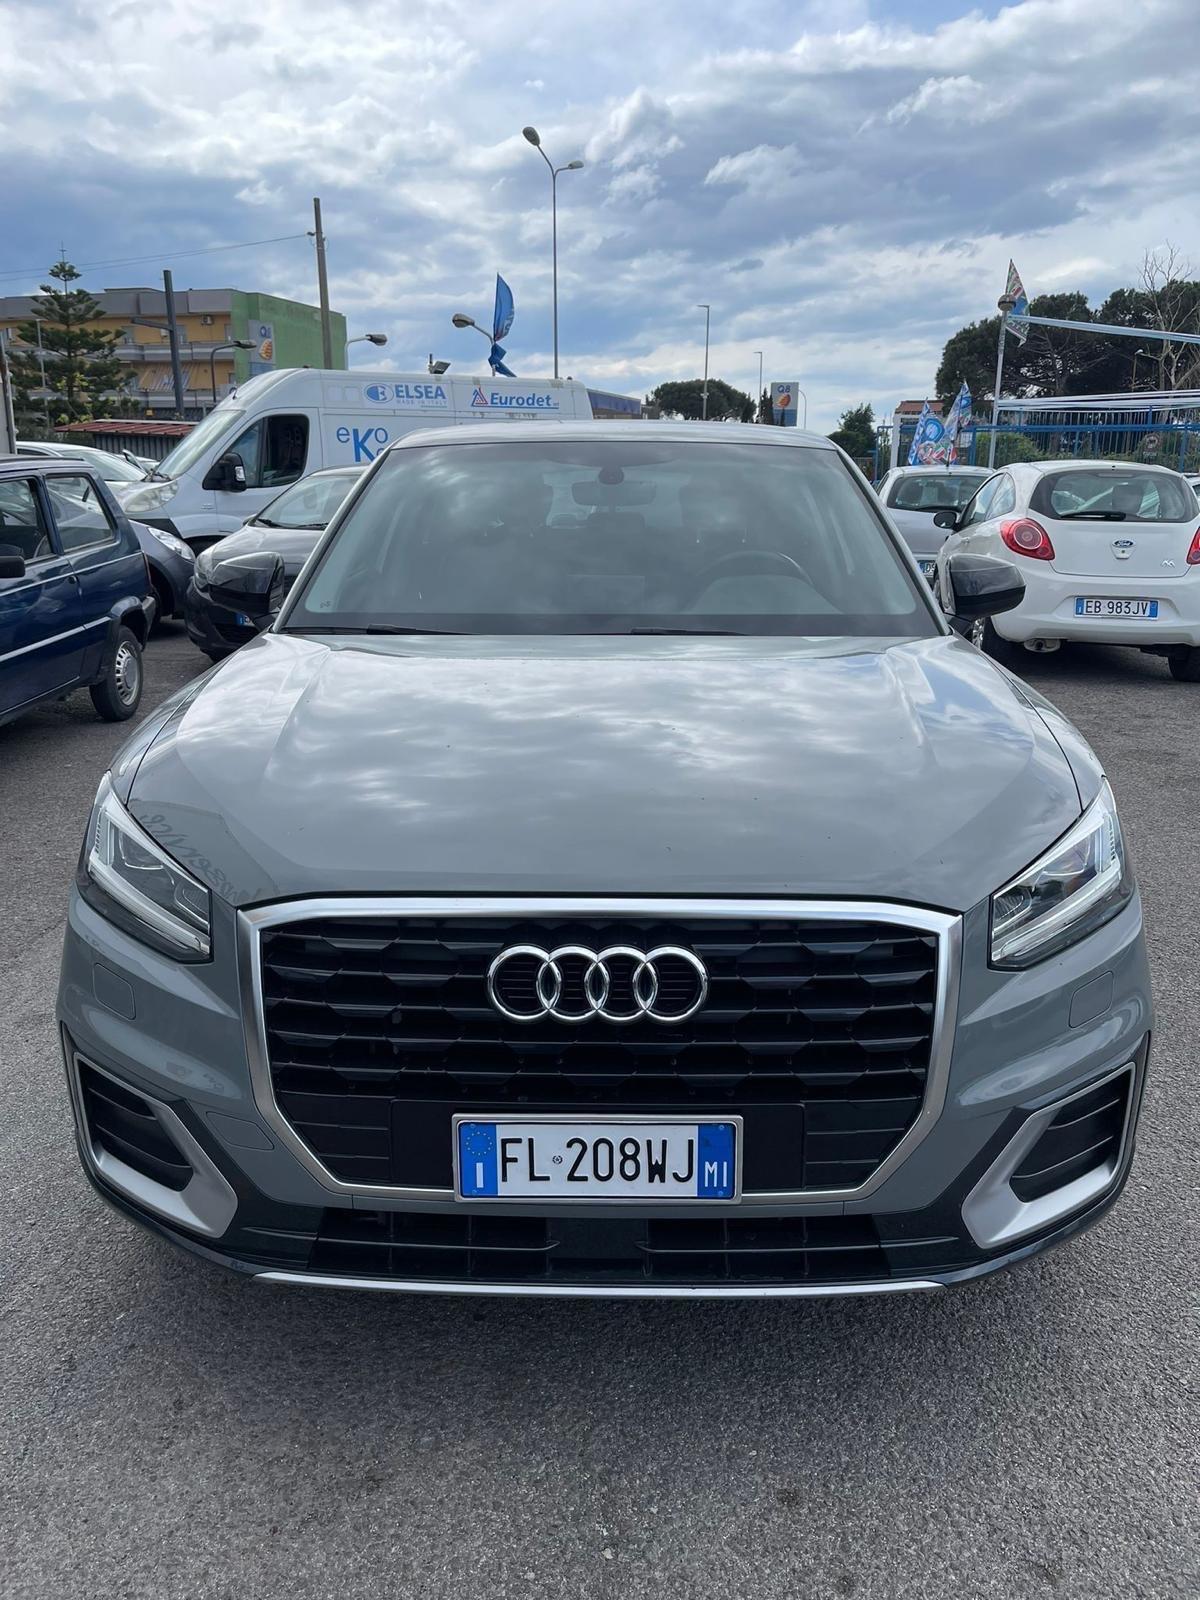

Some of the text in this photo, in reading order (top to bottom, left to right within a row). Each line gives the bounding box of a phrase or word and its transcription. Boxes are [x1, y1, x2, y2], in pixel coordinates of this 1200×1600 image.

[395, 384, 447, 399] ELSEA
[777, 384, 791, 393] Q8
[491, 393, 552, 406] Eurodet
[1085, 600, 1148, 615] EB 983JV
[500, 1137, 694, 1183] FL 208WJ
[476, 1162, 484, 1188] I
[704, 1161, 728, 1188] MI
